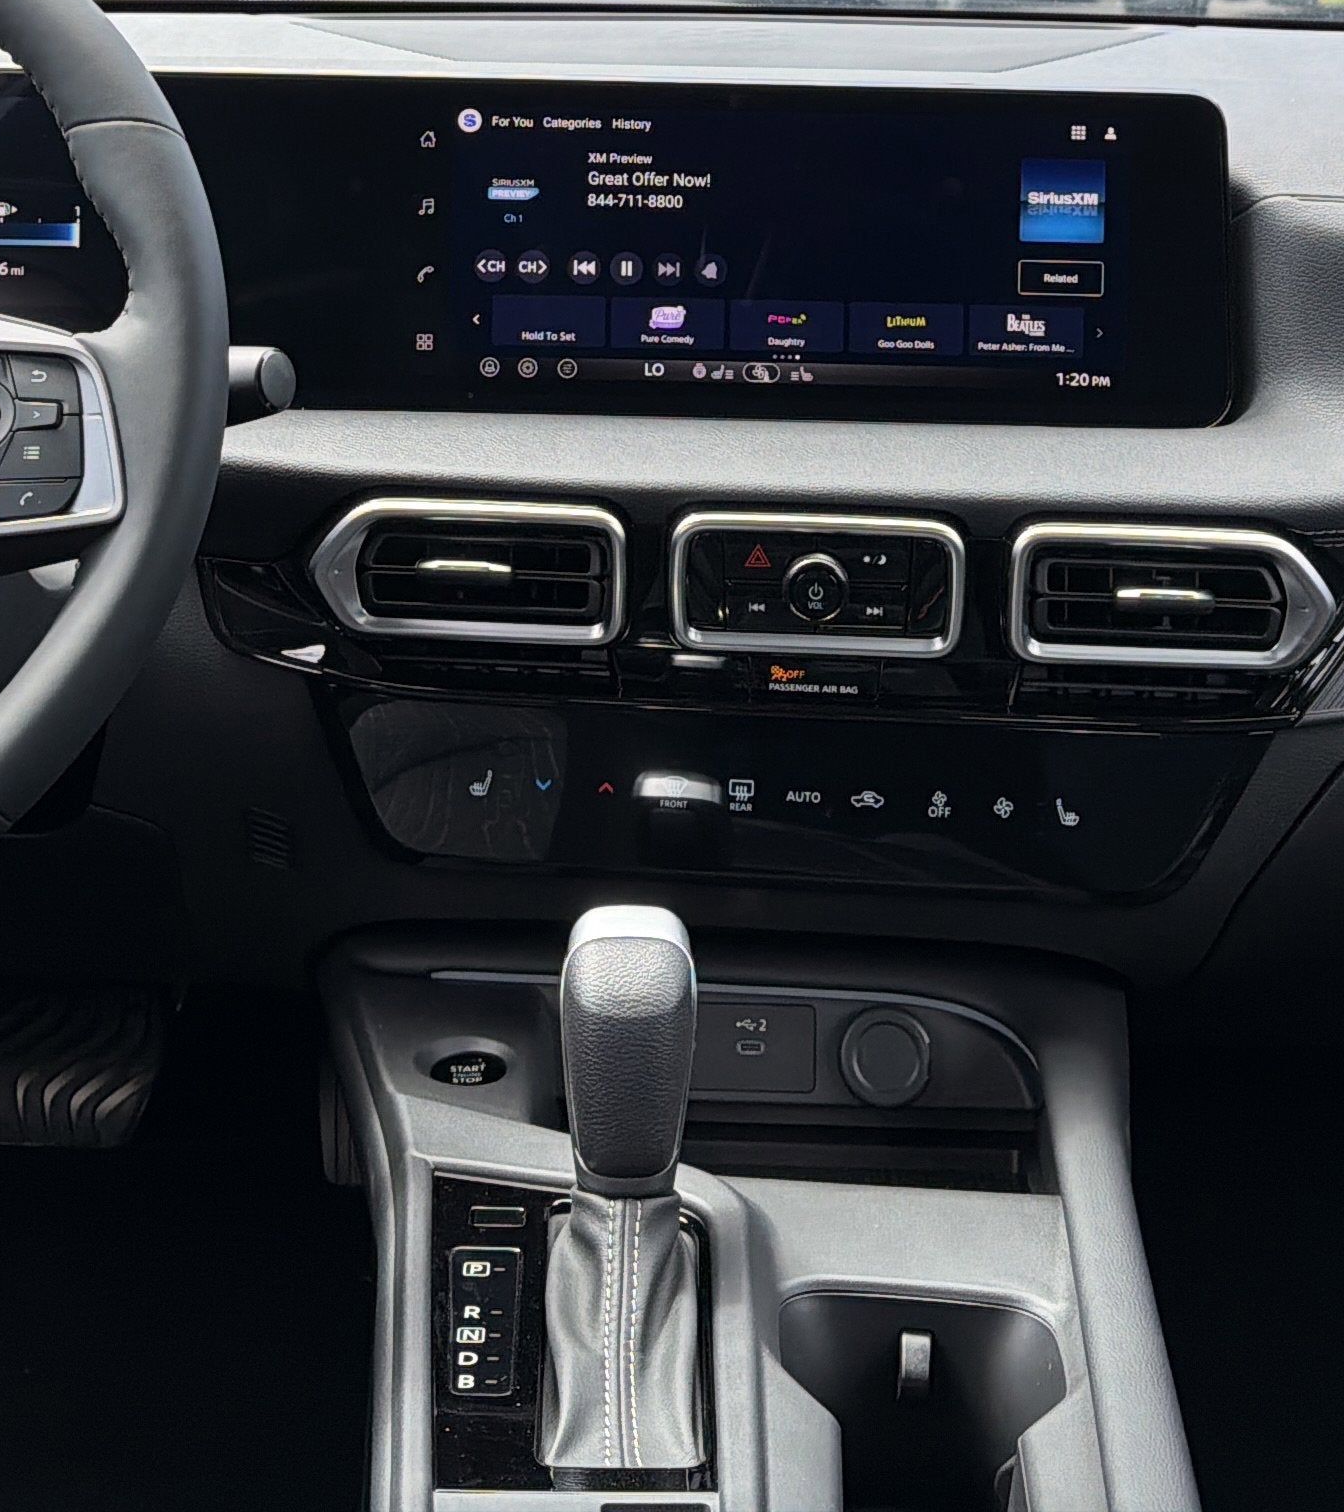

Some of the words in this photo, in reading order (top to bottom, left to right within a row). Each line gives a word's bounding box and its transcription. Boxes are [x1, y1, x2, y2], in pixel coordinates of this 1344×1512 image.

[492, 116, 510, 127] For
[513, 116, 534, 128] You
[543, 116, 602, 130] Categories
[612, 118, 652, 132] History
[588, 153, 606, 164] XM
[609, 153, 653, 165] Preview
[588, 171, 629, 186] Great
[632, 171, 669, 187] Offer
[672, 173, 711, 188] Now!
[587, 194, 683, 209] 844-711-8800
[1027, 191, 1098, 205] SiriusXM
[504, 213, 516, 223] Ch
[10, 265, 25, 276] mi
[1044, 274, 1078, 284] Related
[521, 331, 543, 341] Hold
[546, 331, 557, 342] To
[560, 331, 576, 342] Set
[641, 334, 659, 343] Pure
[661, 335, 694, 346] Comedy
[768, 337, 805, 348] Daughtry
[878, 340, 894, 348] Goo
[896, 340, 913, 348] Goo
[915, 340, 935, 349] Dolls
[978, 342, 1000, 351] Peter
[1029, 343, 1050, 352] From
[1051, 344, 1065, 352] Me
[644, 363, 664, 376] LO
[1056, 373, 1089, 387] 1:20
[1091, 376, 1110, 387] PM
[808, 601, 824, 610] VOL
[787, 670, 805, 679] OFF
[769, 683, 820, 692] PASSENGER
[822, 685, 837, 693] AIR
[840, 686, 858, 694] BAG
[786, 791, 821, 803] AUTO
[659, 799, 688, 809] FRONT
[729, 802, 753, 811] REAR
[928, 806, 951, 817] OFF
[759, 1019, 767, 1031] 2
[450, 1062, 486, 1073] START
[470, 1264, 483, 1275] P
[464, 1306, 481, 1319] R
[463, 1330, 479, 1341] N
[458, 1352, 479, 1366] D
[457, 1375, 475, 1389] B
